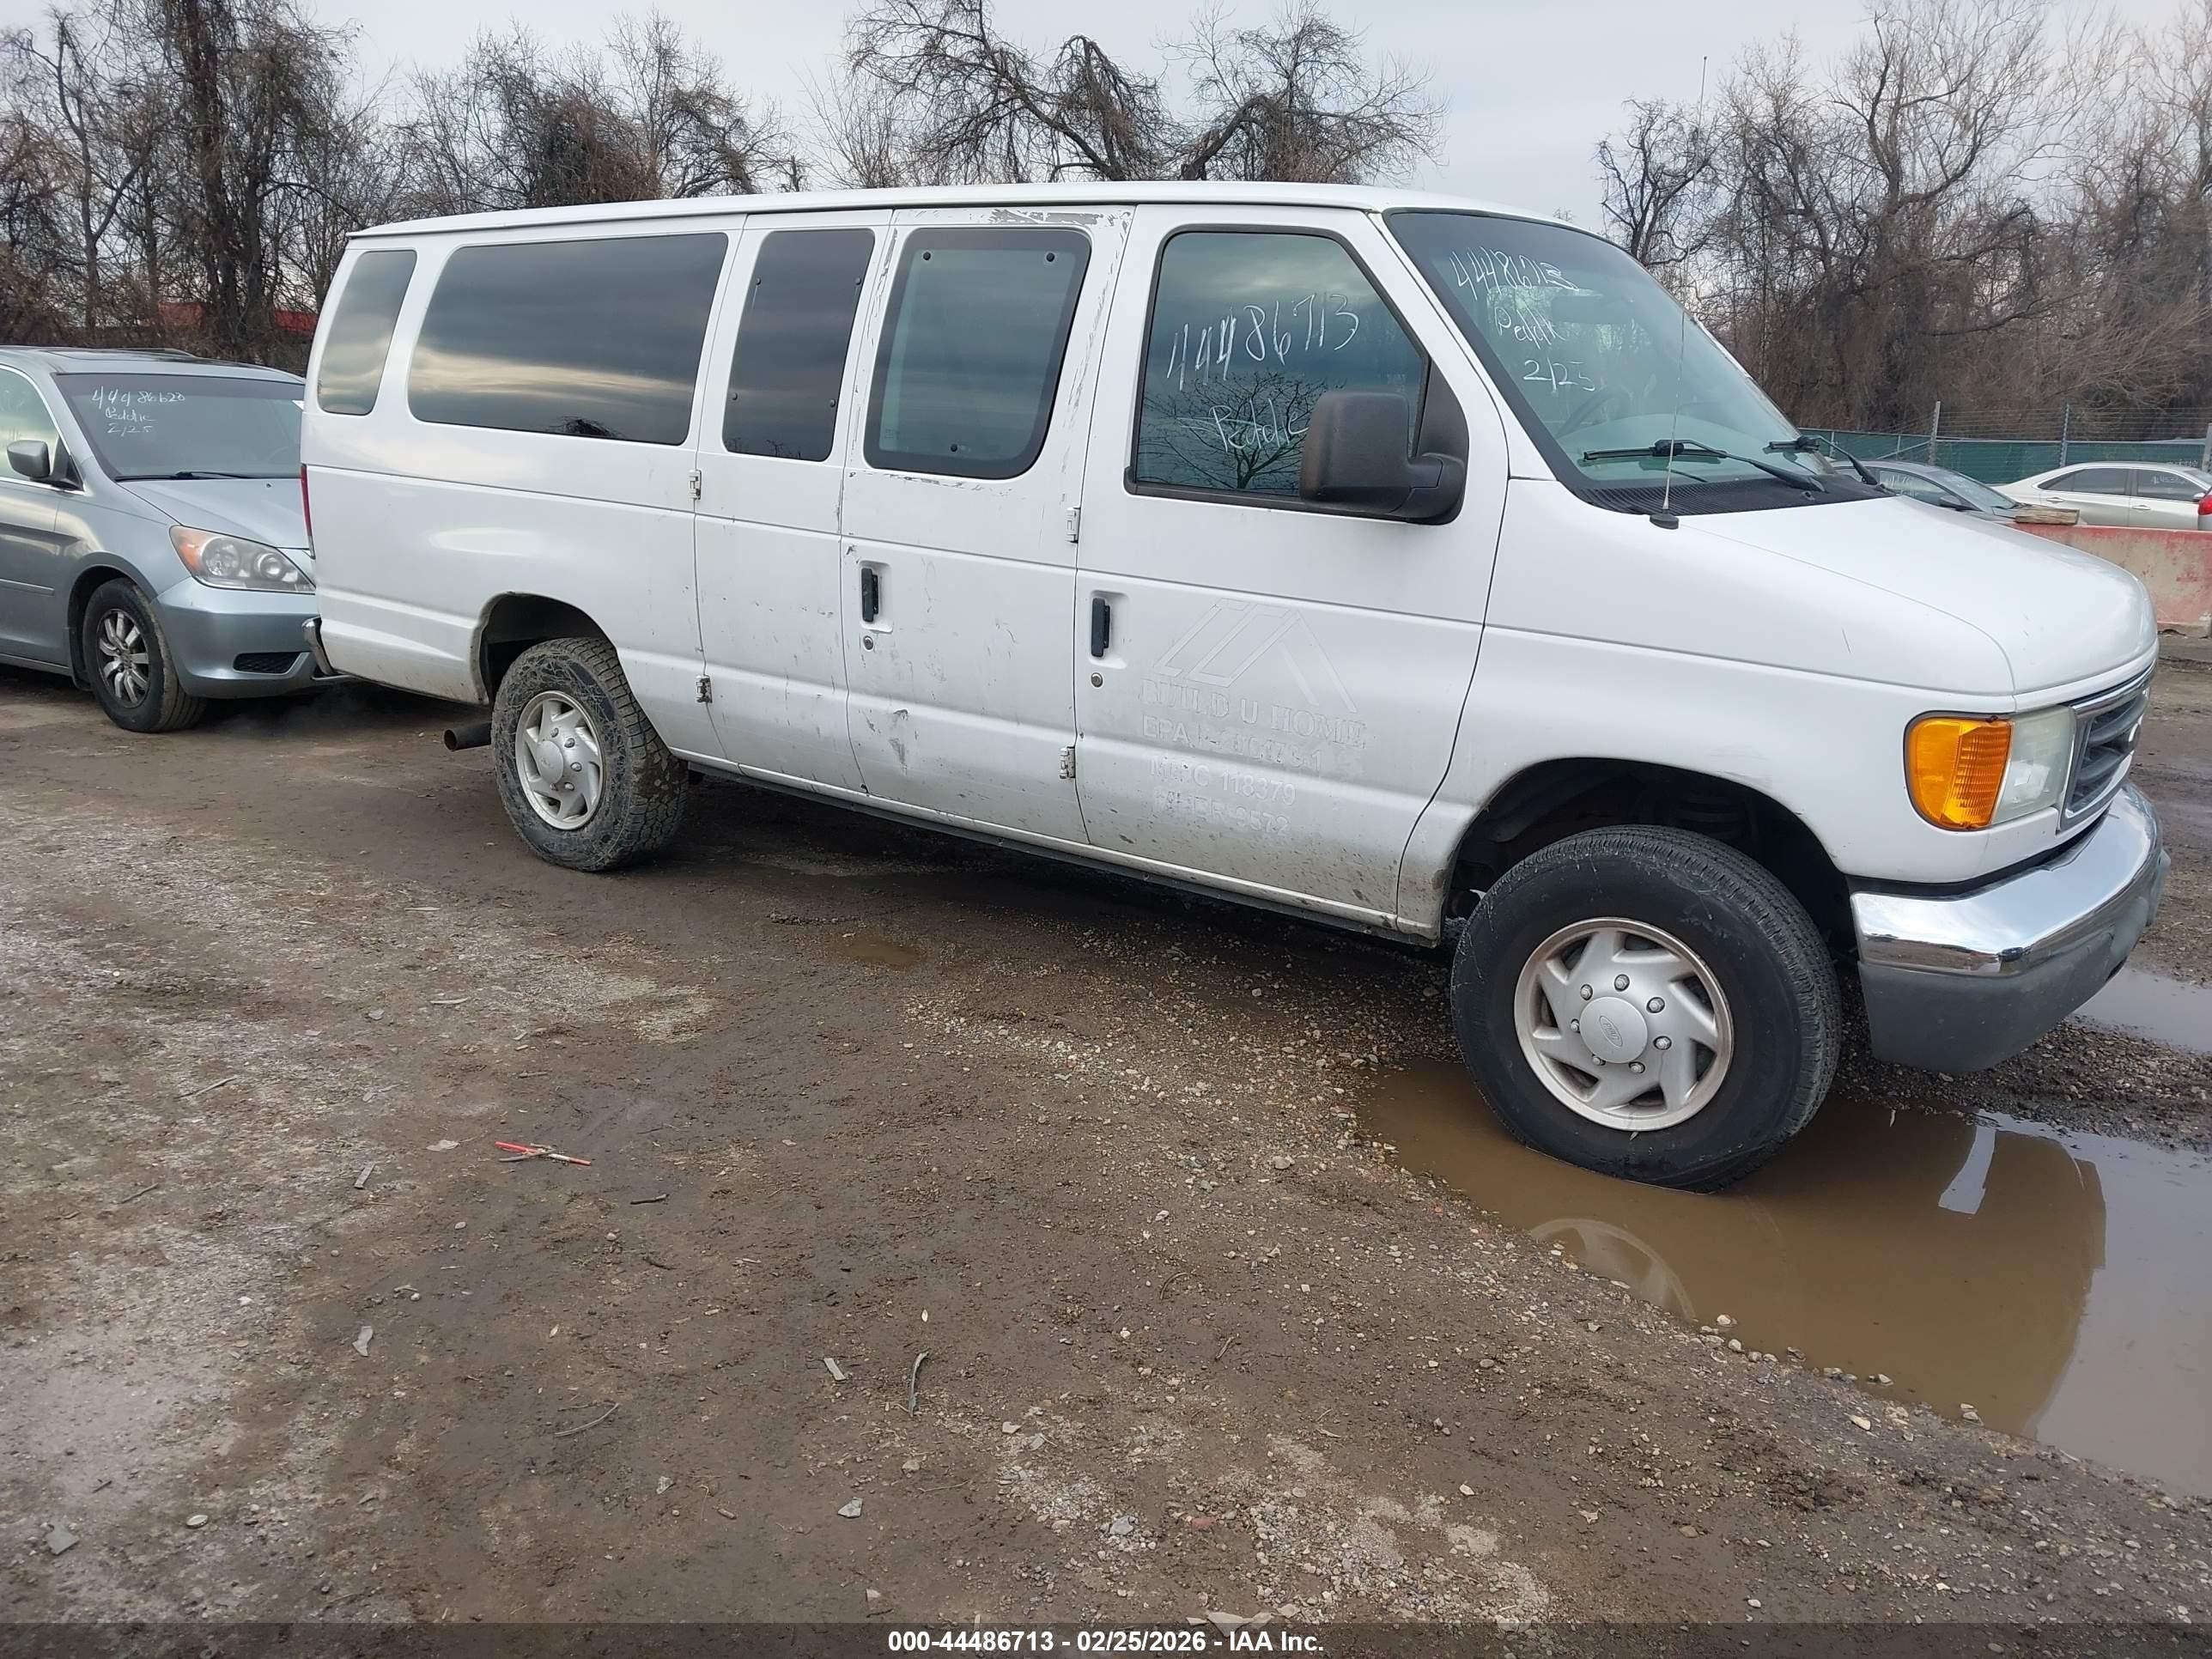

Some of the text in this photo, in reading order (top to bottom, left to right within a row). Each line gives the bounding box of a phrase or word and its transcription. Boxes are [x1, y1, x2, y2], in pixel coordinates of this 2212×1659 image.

[1166, 293, 1360, 392] 44486713
[1142, 714, 1191, 744] EPA
[1241, 699, 1259, 725] U
[1270, 704, 1367, 750] HOME
[1222, 770, 1297, 805] 118379
